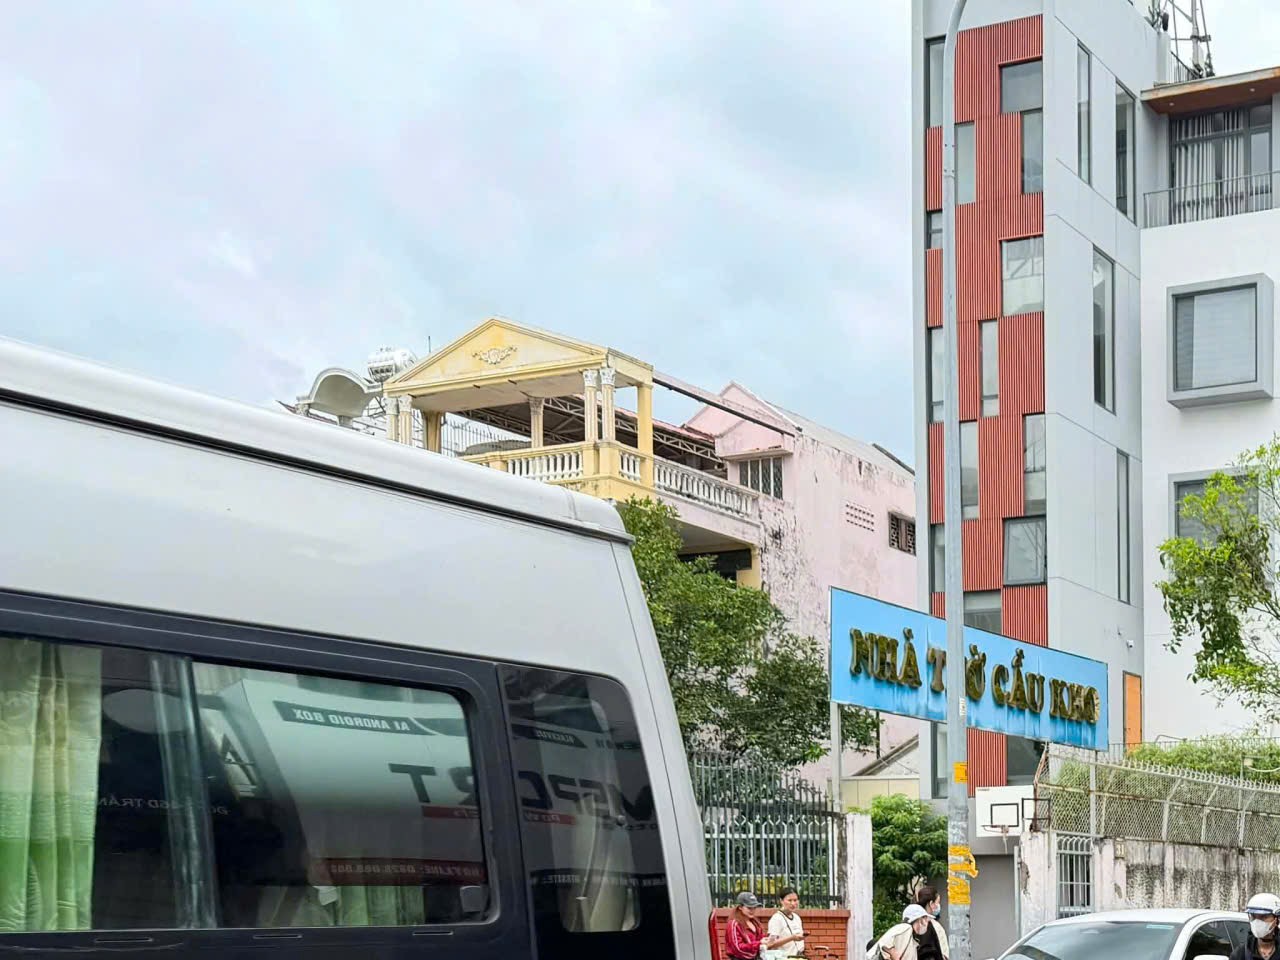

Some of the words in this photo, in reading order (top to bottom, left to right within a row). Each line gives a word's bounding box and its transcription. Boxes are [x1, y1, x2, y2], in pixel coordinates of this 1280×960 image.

[850, 627, 922, 688] NHÀ
[927, 643, 987, 701] TỜ
[1050, 676, 1100, 724] KHO
